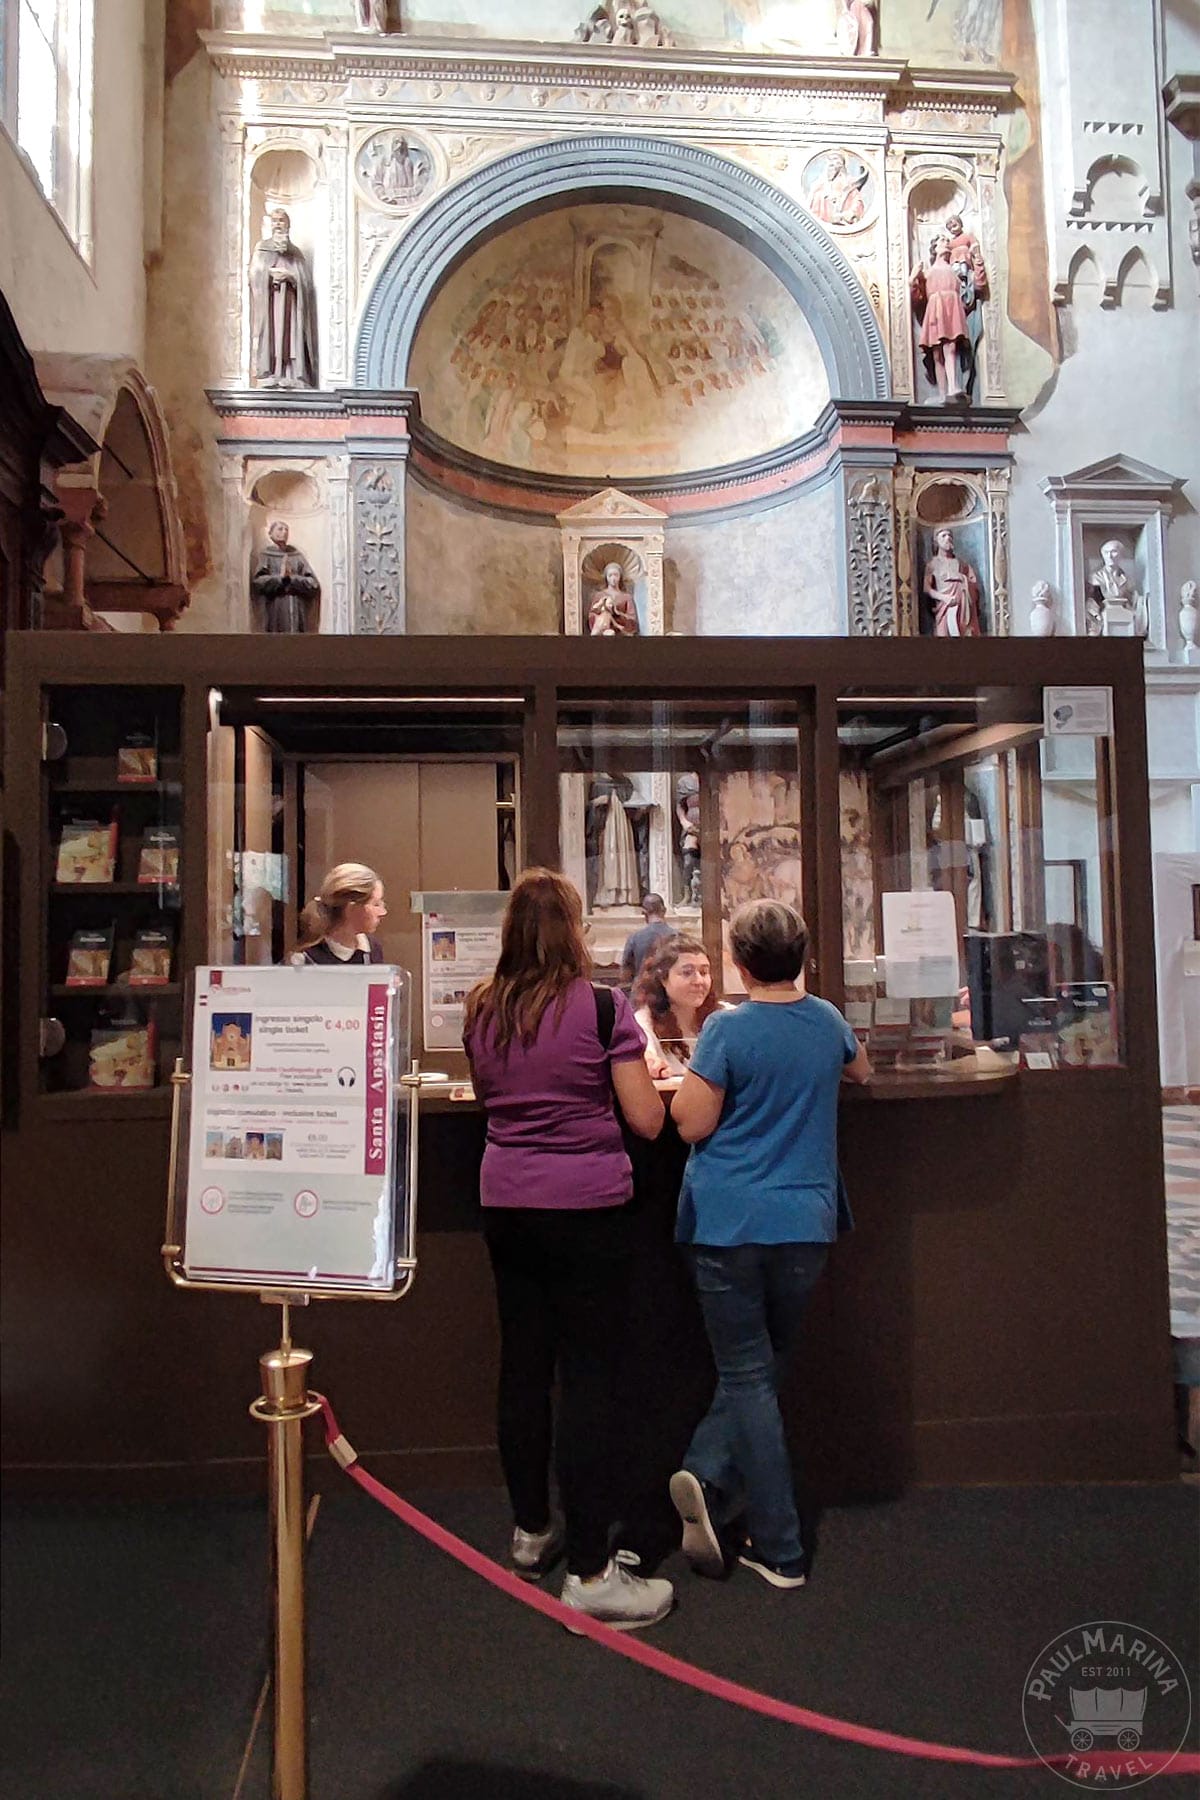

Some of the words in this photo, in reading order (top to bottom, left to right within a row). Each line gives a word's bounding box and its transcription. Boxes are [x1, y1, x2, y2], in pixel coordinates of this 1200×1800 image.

[285, 1025, 309, 1034] ticket
[334, 1019, 360, 1031] 4,00
[370, 1006, 385, 1093] Anastasia
[368, 1107, 384, 1159] Santa
